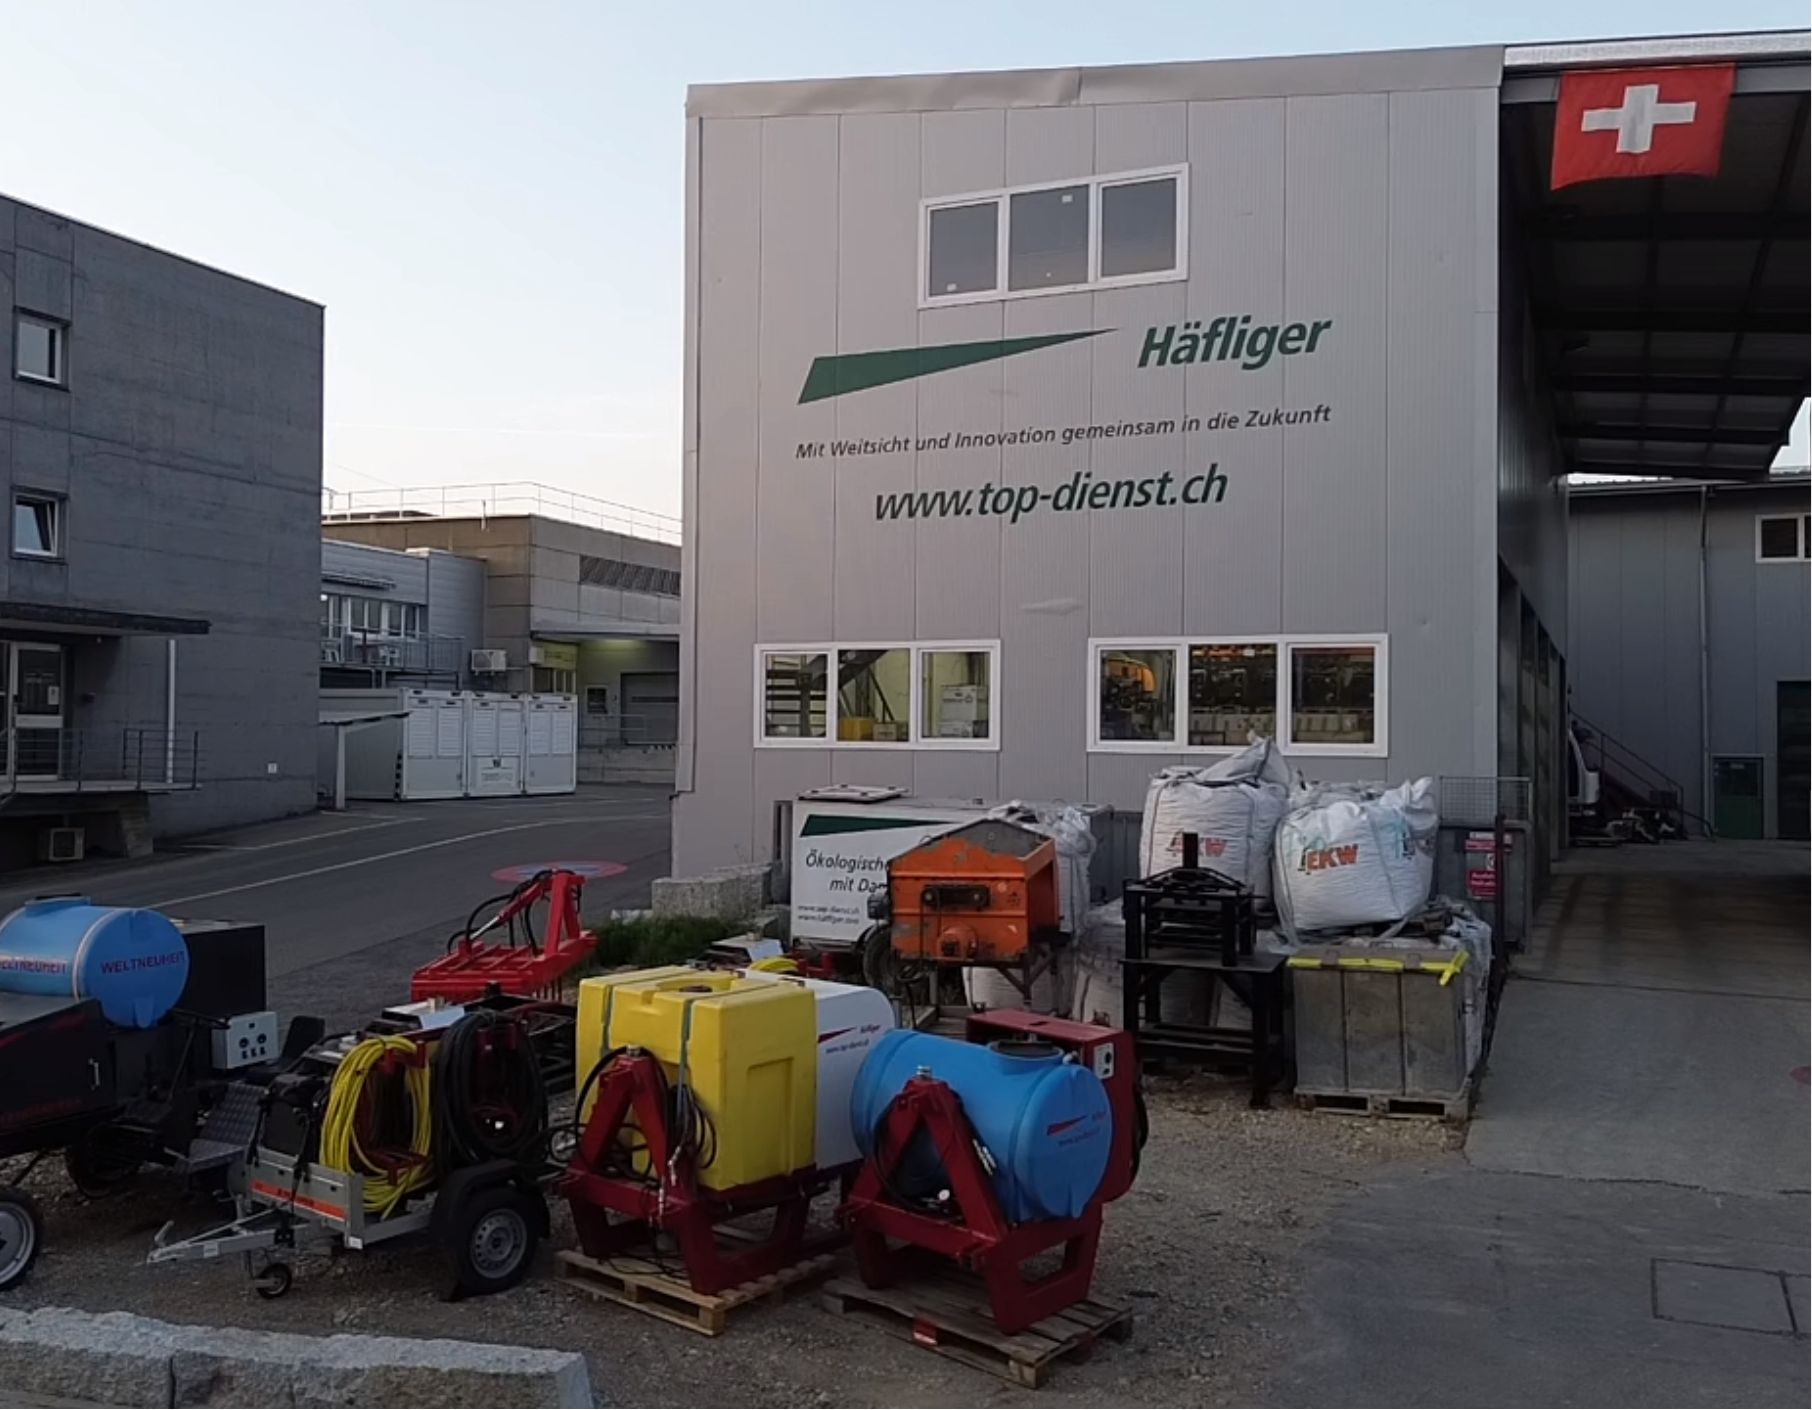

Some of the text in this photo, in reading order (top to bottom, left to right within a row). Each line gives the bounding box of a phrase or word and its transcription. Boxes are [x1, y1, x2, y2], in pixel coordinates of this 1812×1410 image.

[1137, 315, 1333, 370] Häfliger
[796, 404, 1332, 459] Mit Weitsicht und Innovation gemeinsam in die Zukunft
[875, 463, 1229, 524] www.top-dienst.ch
[1308, 844, 1358, 869] EKW
[829, 877, 855, 892] mit
[0, 959, 65, 974] ELTNEUHEIT
[101, 951, 185, 973] WELTNEUHEIT
